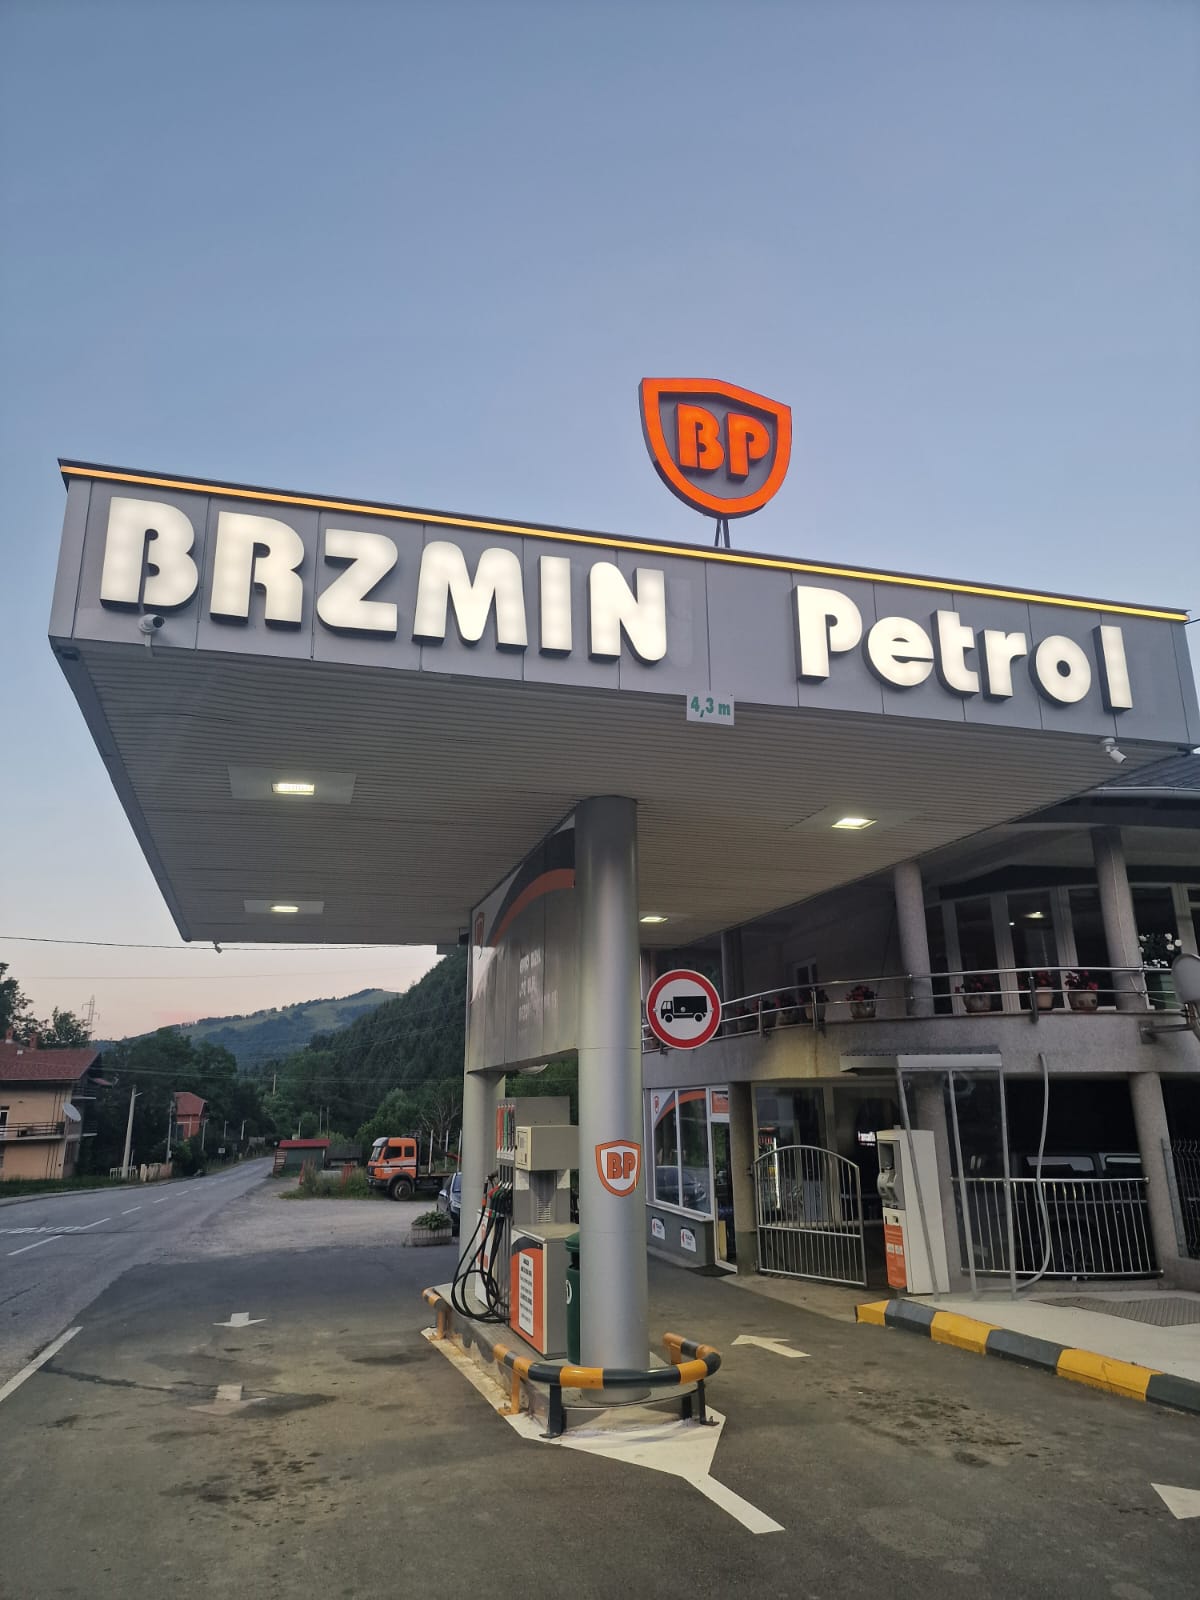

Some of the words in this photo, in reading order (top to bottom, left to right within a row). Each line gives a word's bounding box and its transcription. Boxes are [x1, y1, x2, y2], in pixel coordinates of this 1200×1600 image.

[675, 402, 771, 481] BP
[100, 496, 668, 665] BRZMIN
[794, 585, 1133, 712] Petrol
[690, 696, 714, 718] 4,3
[718, 703, 731, 716] m
[606, 1151, 636, 1179] BP
